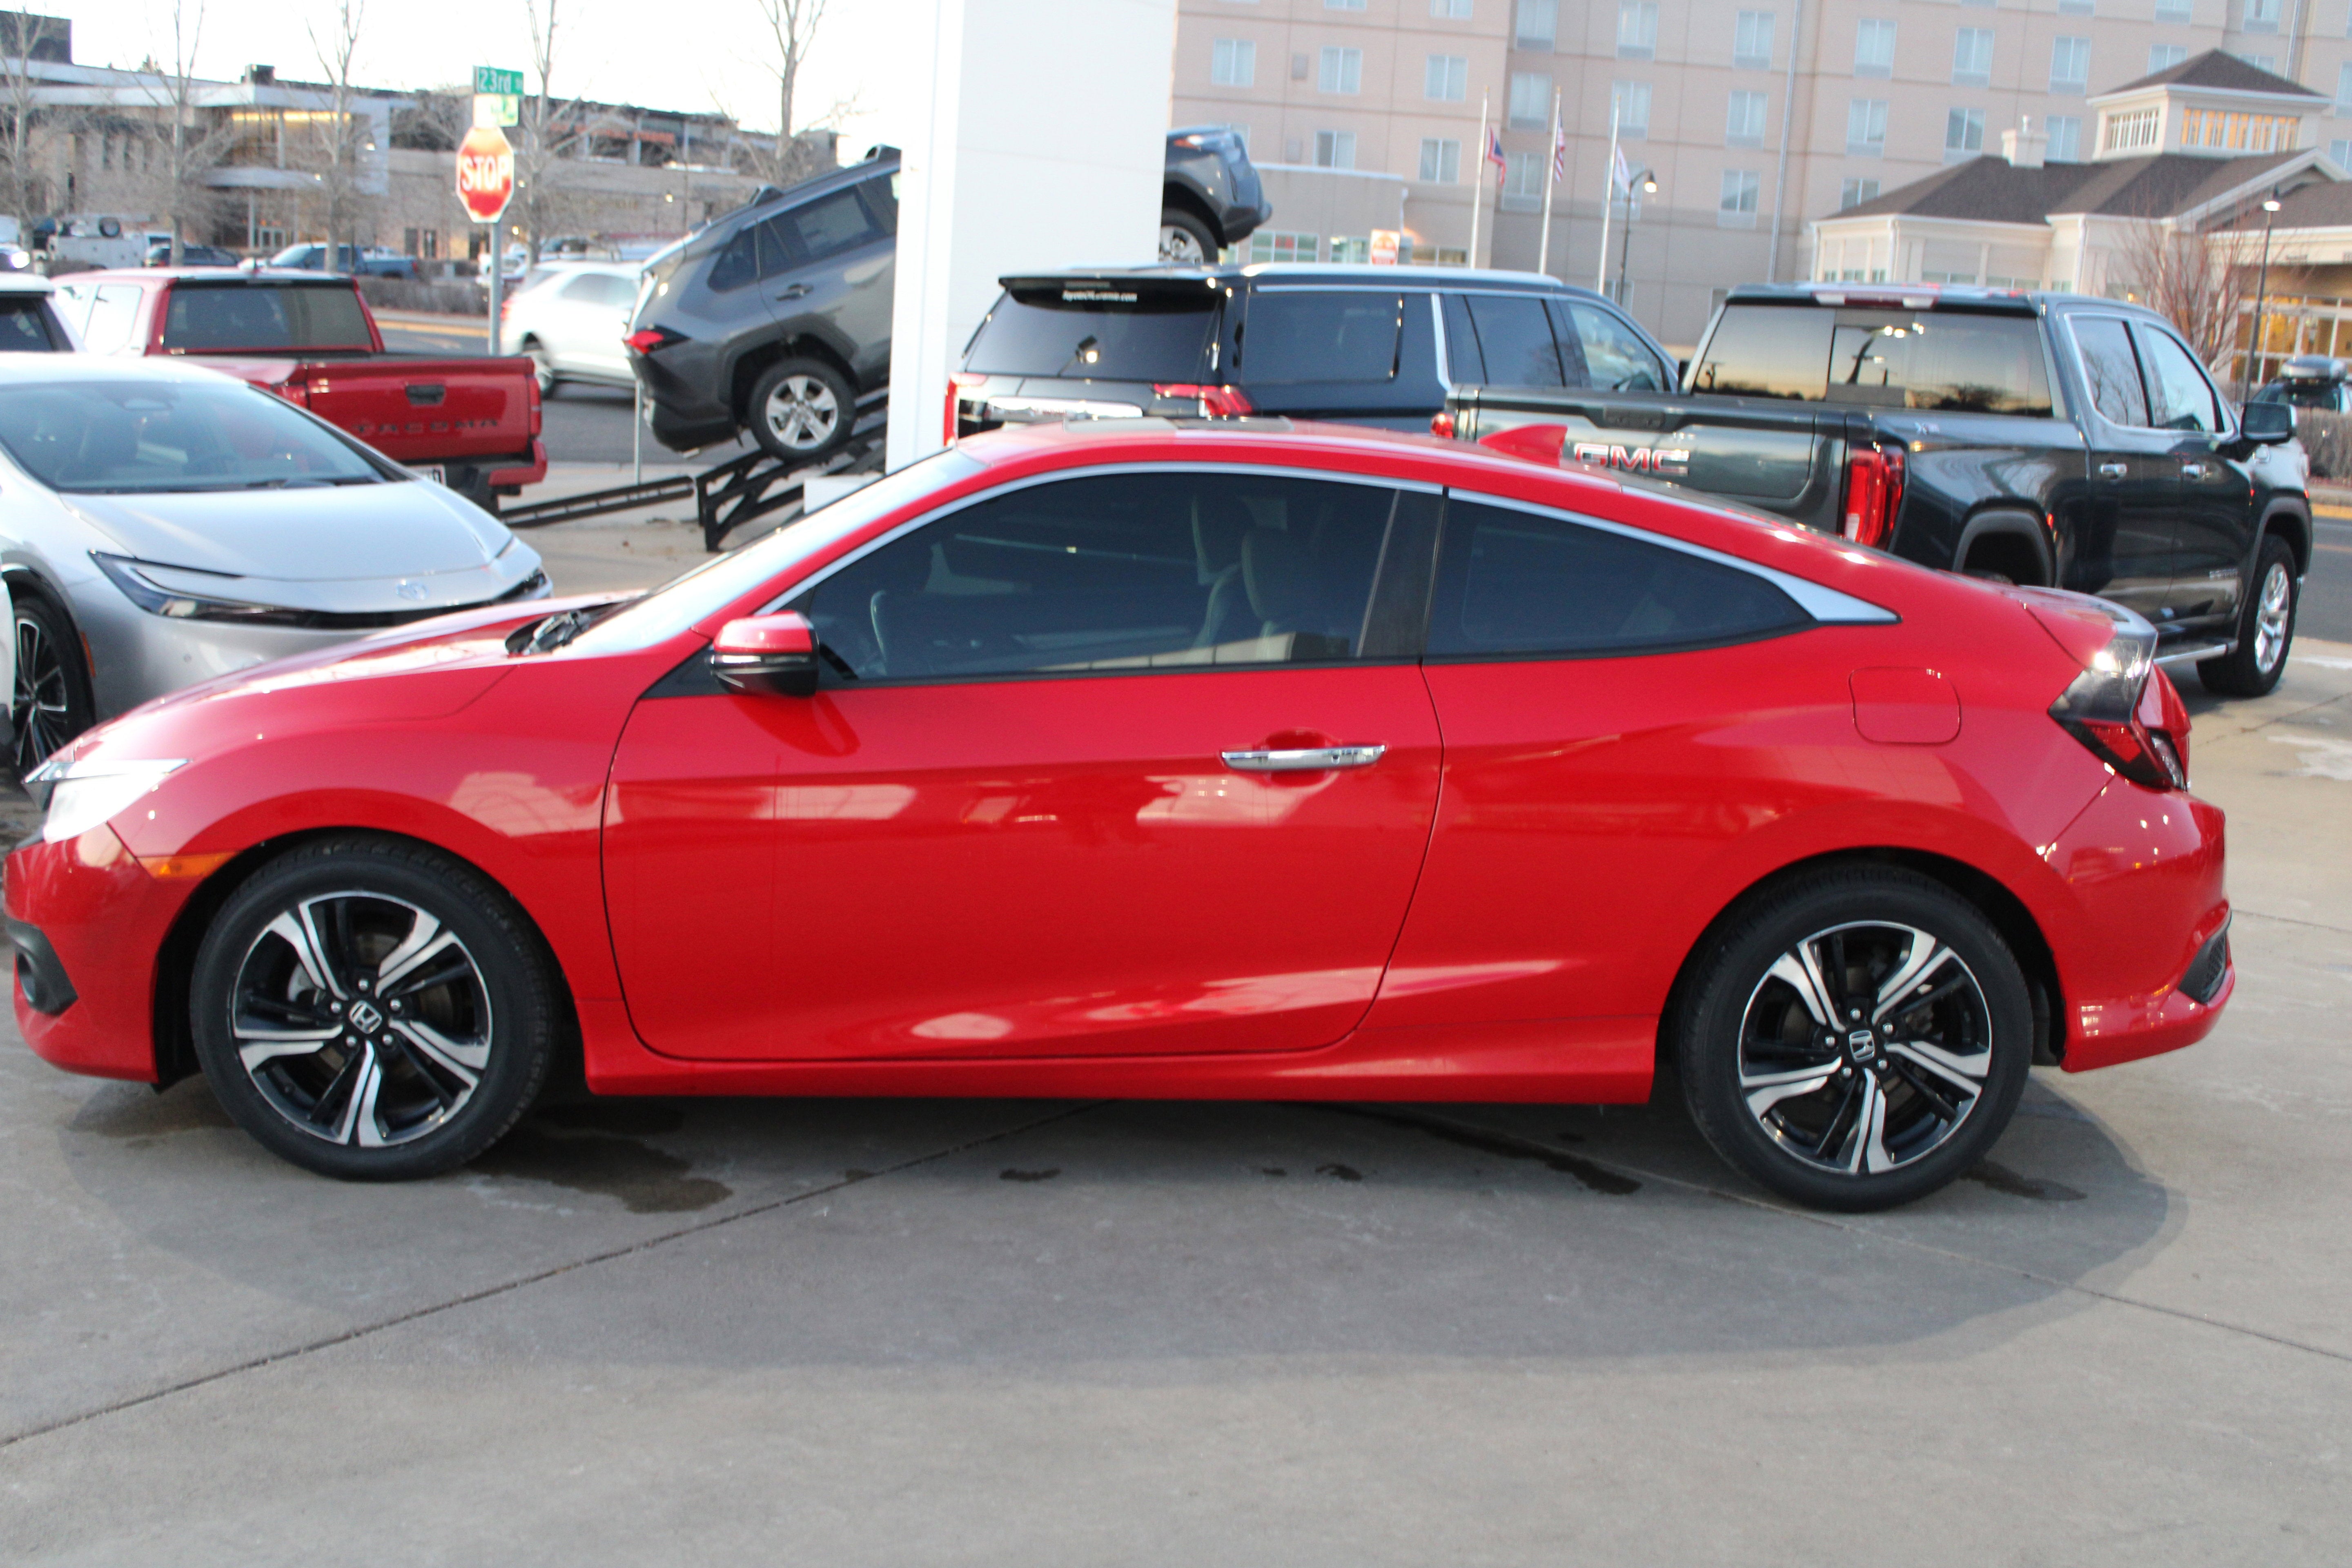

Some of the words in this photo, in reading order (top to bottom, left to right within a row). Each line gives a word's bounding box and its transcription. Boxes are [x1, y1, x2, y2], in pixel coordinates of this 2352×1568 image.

[479, 69, 511, 93] 23rd
[461, 156, 510, 192] STOP
[352, 419, 498, 433] TACOMA
[1574, 443, 1690, 477] GMC
